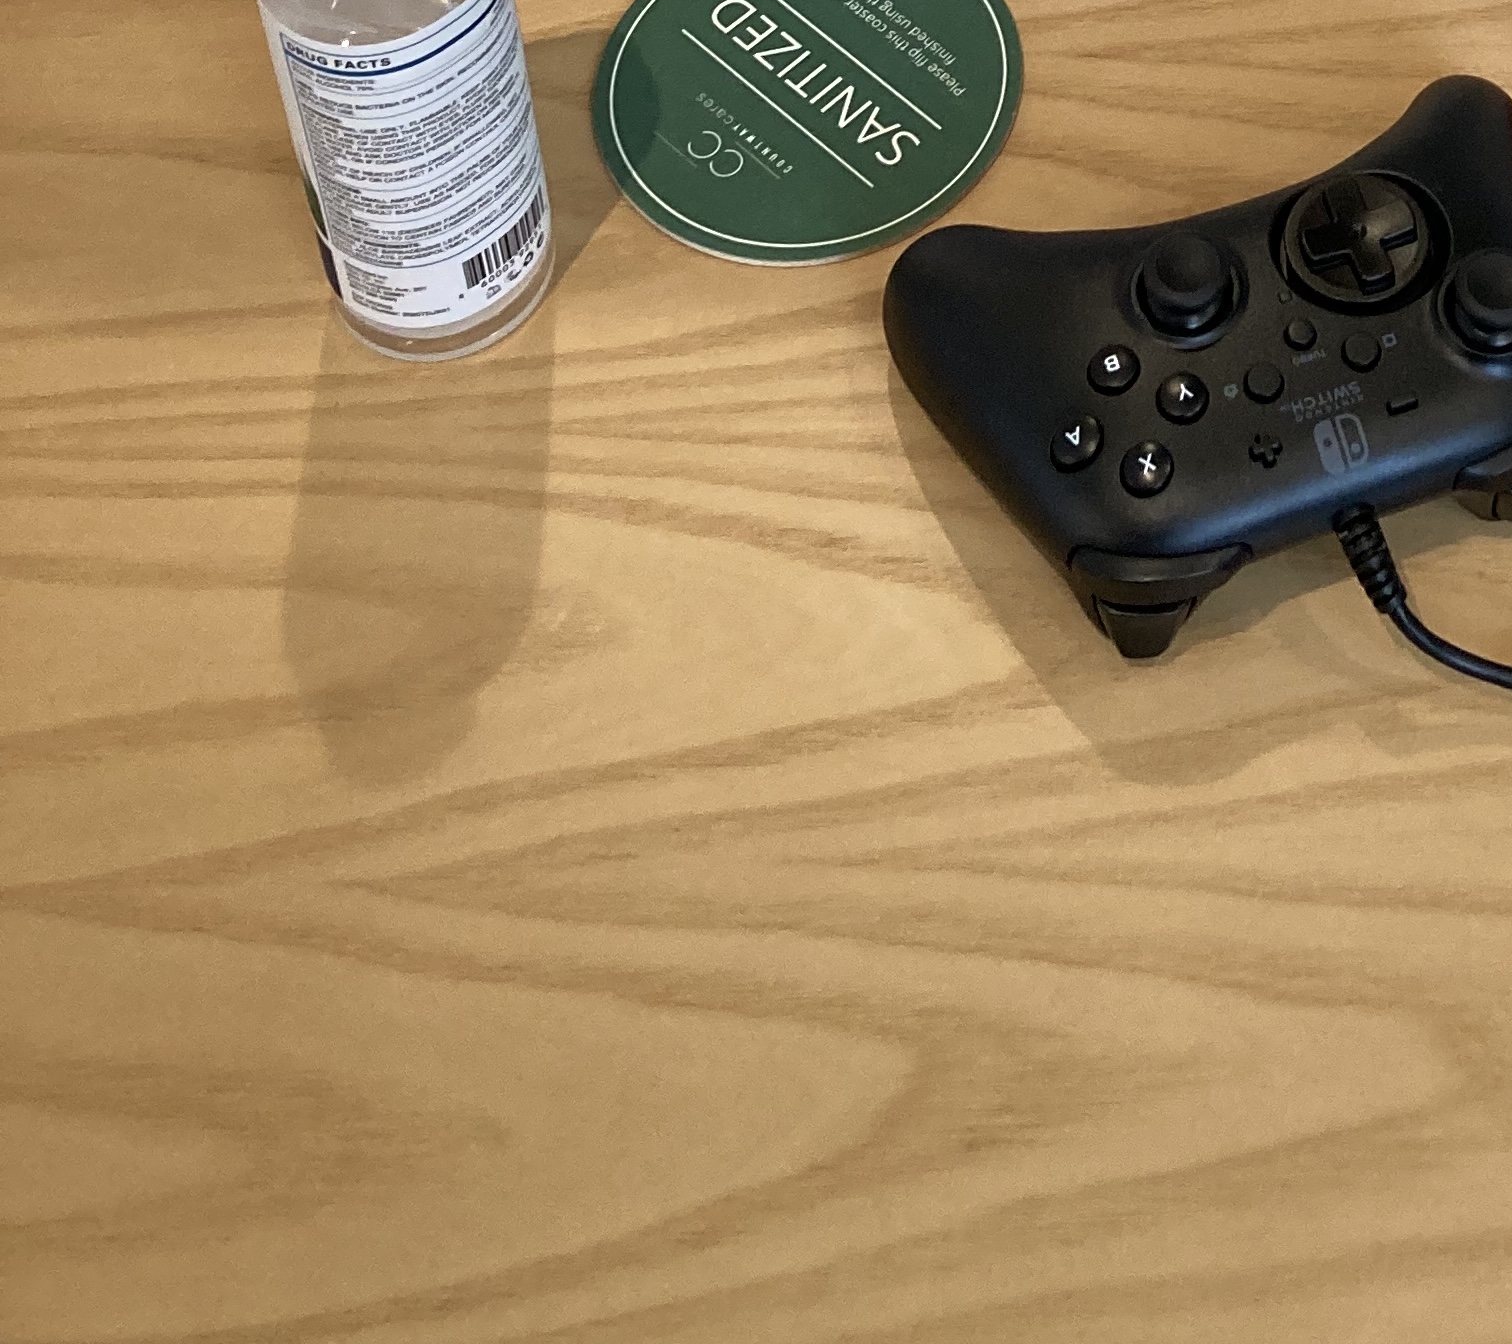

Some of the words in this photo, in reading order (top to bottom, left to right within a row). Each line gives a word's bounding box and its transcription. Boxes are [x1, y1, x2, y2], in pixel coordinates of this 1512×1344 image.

[843, 0, 888, 32] coaster
[878, 0, 912, 29] using
[884, 29, 909, 51] this
[906, 26, 957, 66] finished
[287, 41, 328, 66] DRUG
[334, 57, 392, 69] FACTS
[907, 47, 930, 67] flip
[927, 63, 967, 97] Please
[1103, 354, 1121, 372] B
[1179, 381, 1195, 402] Y
[1297, 380, 1361, 414] SWITCH
[1065, 425, 1082, 445] A
[1138, 452, 1158, 474] X
